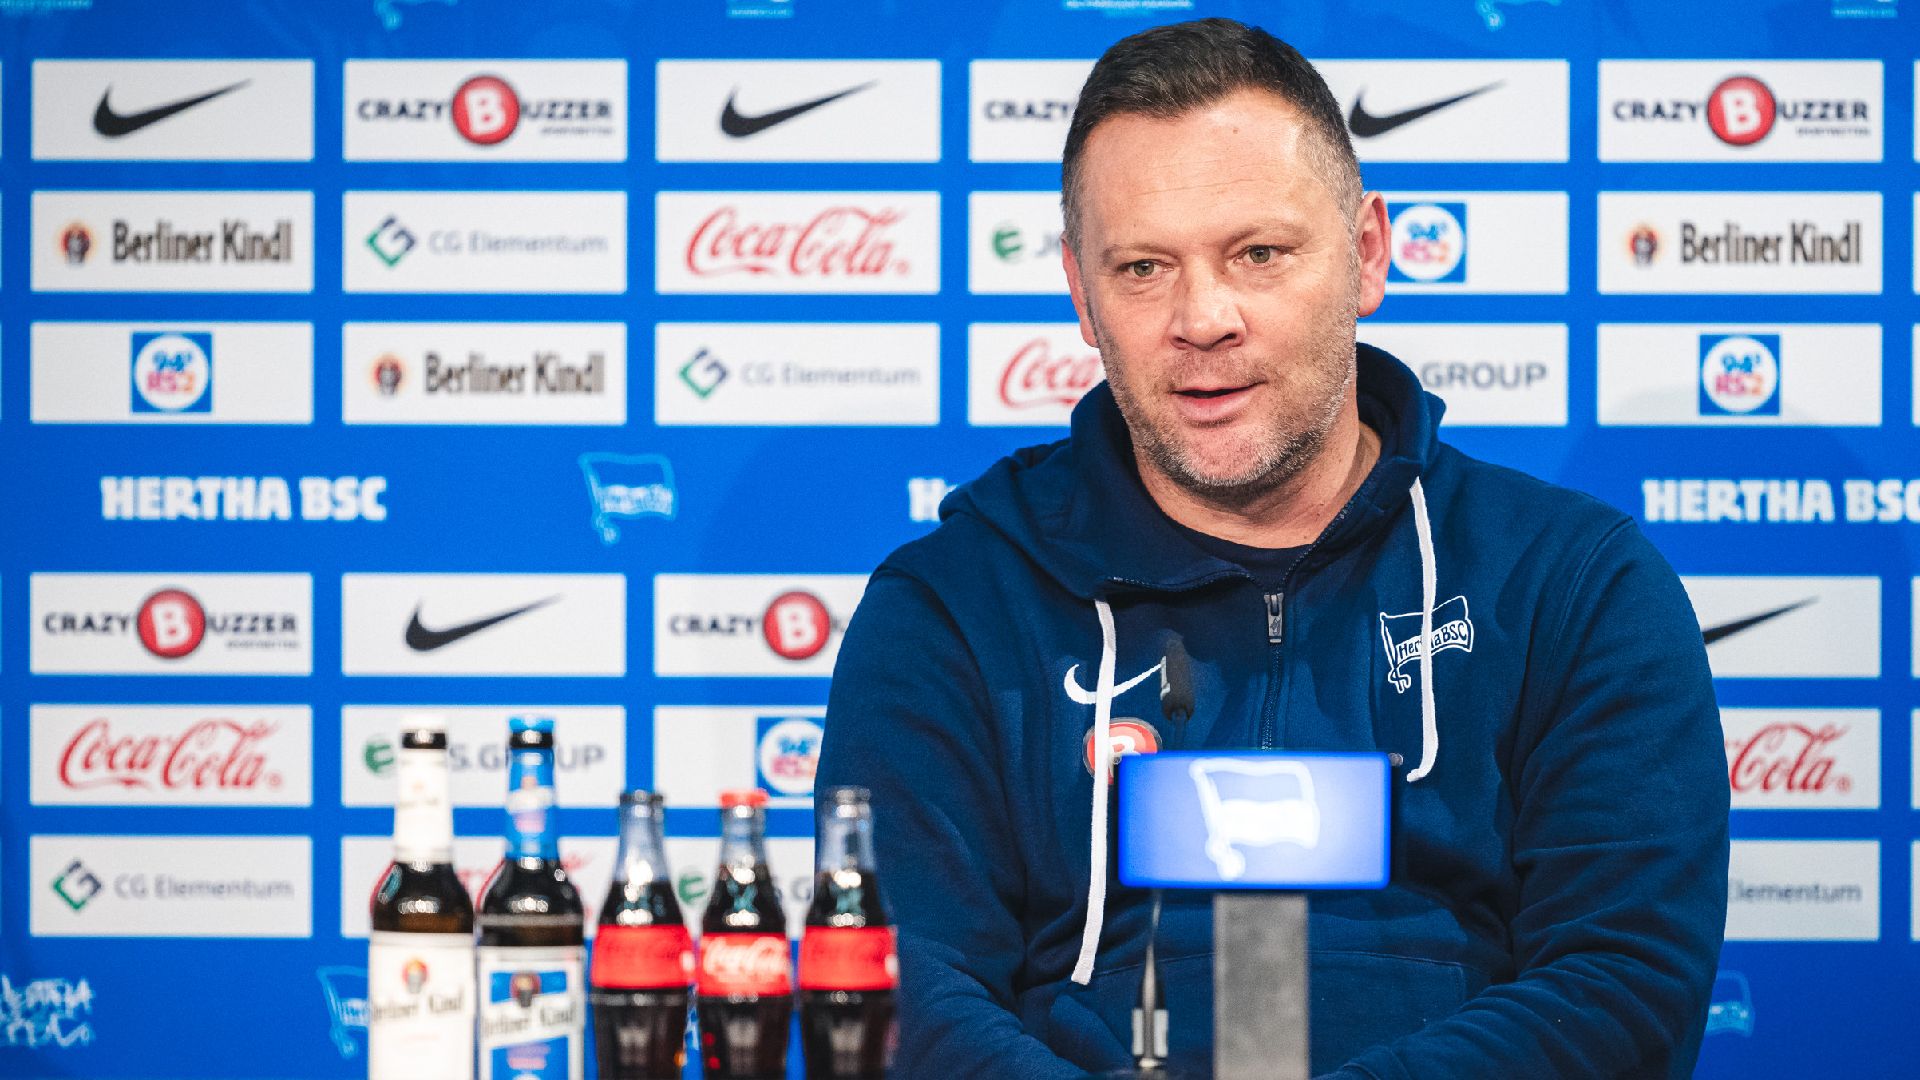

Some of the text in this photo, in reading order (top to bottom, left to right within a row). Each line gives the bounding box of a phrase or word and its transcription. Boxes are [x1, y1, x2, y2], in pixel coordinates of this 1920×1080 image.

[357, 99, 447, 121] CRAZY
[984, 100, 1074, 121] CRAZY
[1613, 100, 1700, 121] CRAZY
[112, 219, 292, 264] Berliner Kindl
[429, 230, 608, 253] CG Elementum
[1680, 222, 1862, 265] Berliner Kindl
[425, 351, 605, 396] Berliner Kindl
[742, 362, 920, 385] CG Elementum
[1421, 362, 1547, 388] GROUP
[101, 476, 387, 521] HERTHA BSC
[1642, 479, 1835, 522] HERTHA
[42, 612, 131, 635] CRAZY
[669, 614, 757, 636] CRAZY
[113, 873, 294, 899] CG Elementum
